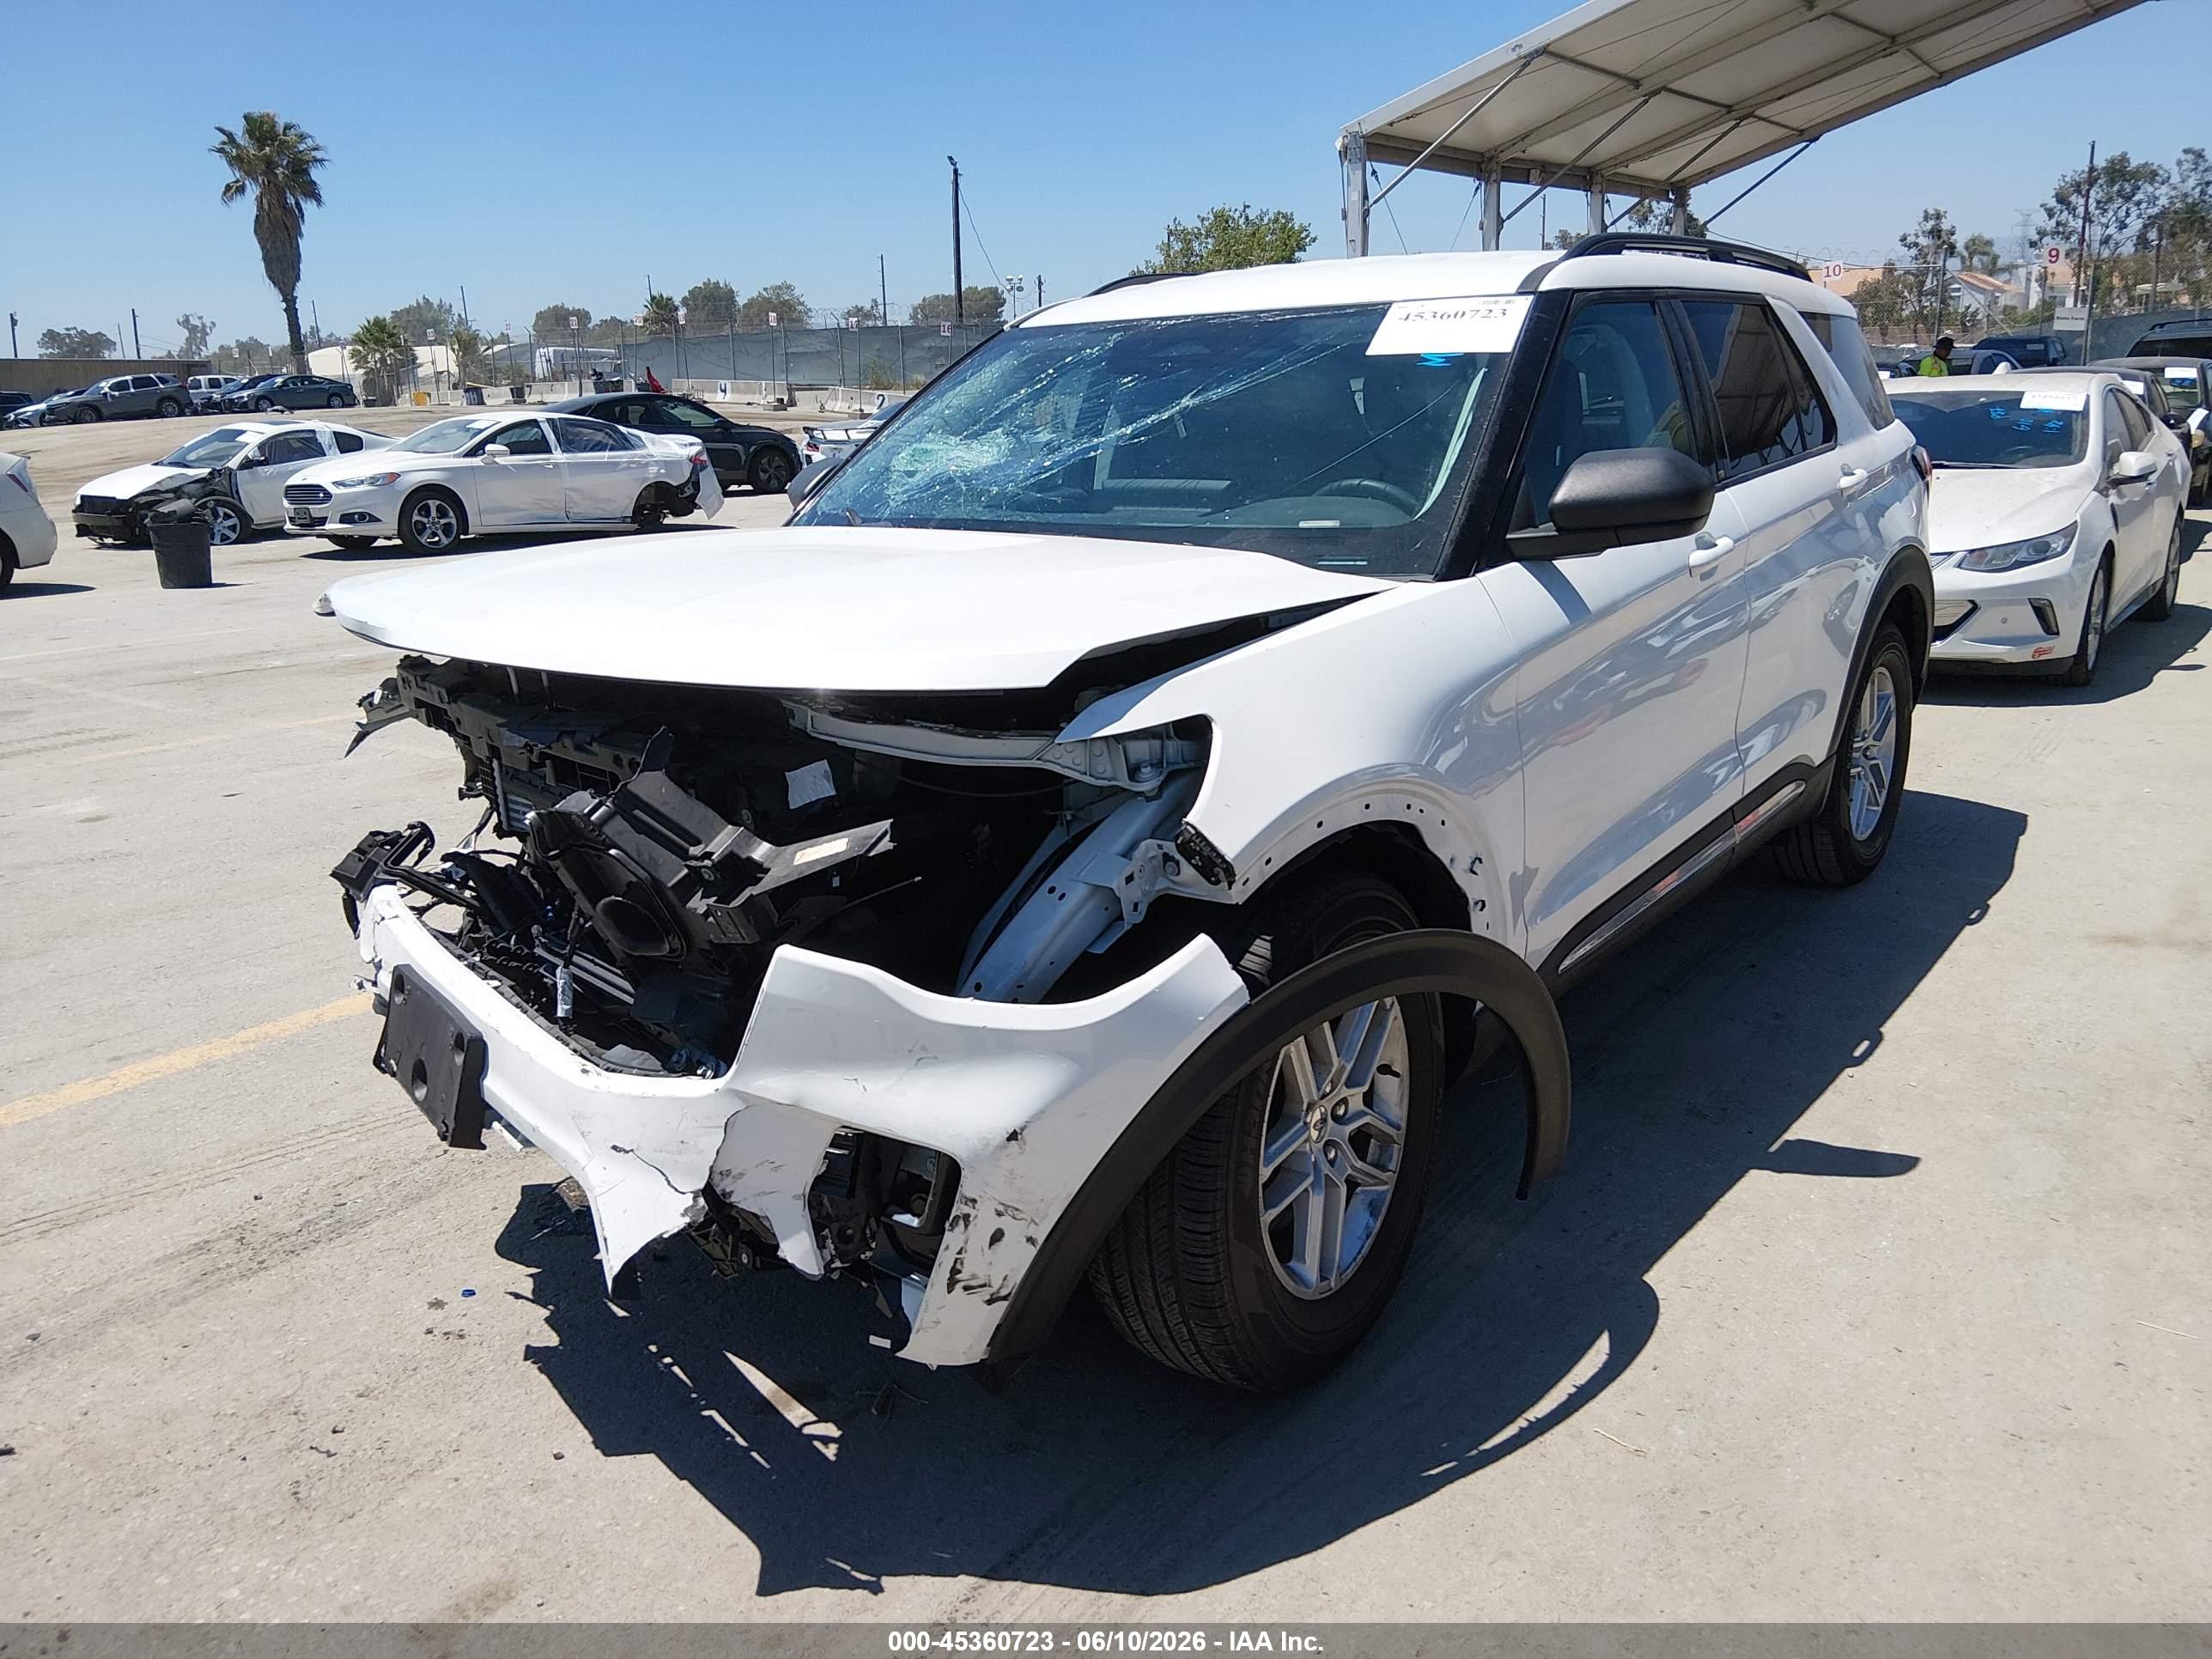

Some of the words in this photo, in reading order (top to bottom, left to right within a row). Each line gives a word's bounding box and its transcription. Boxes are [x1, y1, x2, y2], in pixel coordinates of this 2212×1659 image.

[2048, 247, 2060, 264] 9
[1823, 264, 1842, 278] 10
[1398, 307, 1508, 323] 45360723
